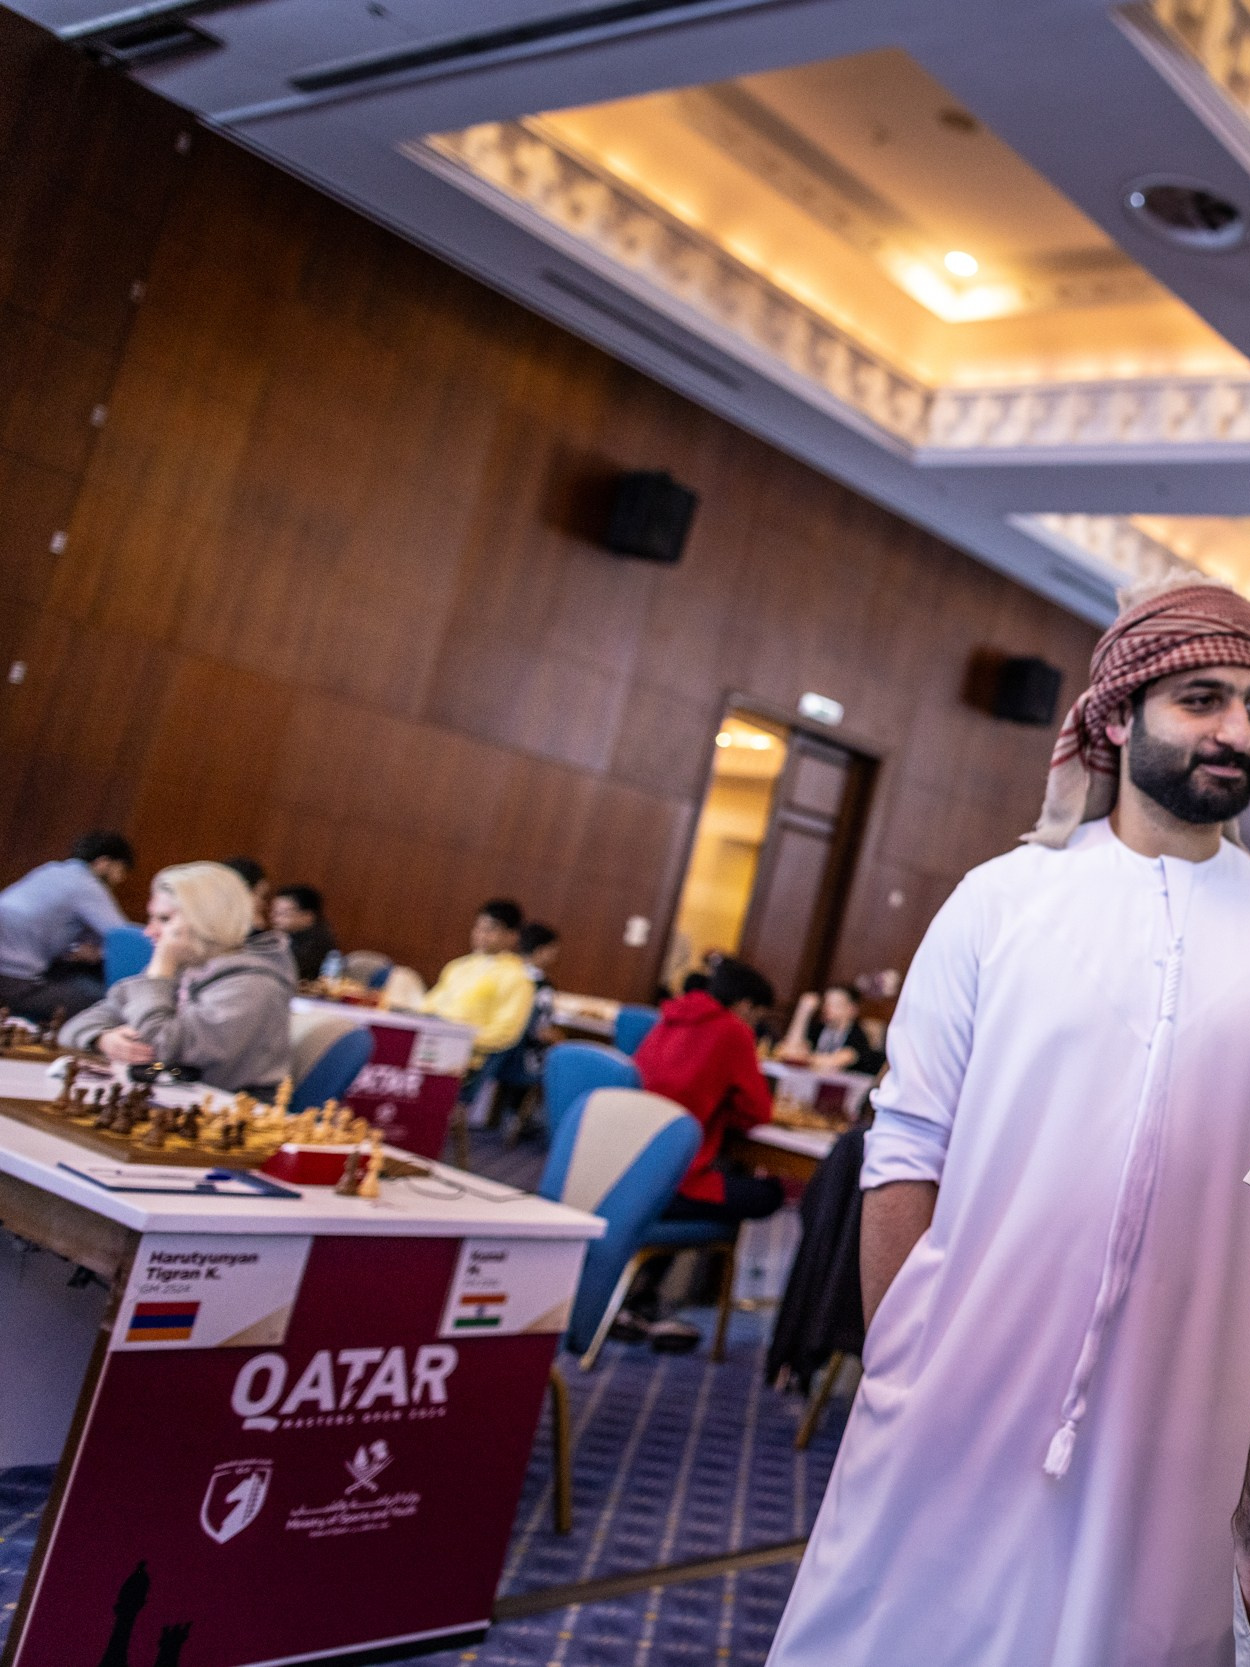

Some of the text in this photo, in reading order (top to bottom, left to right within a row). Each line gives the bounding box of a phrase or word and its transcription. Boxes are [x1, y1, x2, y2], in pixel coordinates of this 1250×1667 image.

[149, 1250, 260, 1268] Harutyunyan
[146, 1266, 222, 1283] Tigran K.
[231, 1343, 459, 1432] QATAR
